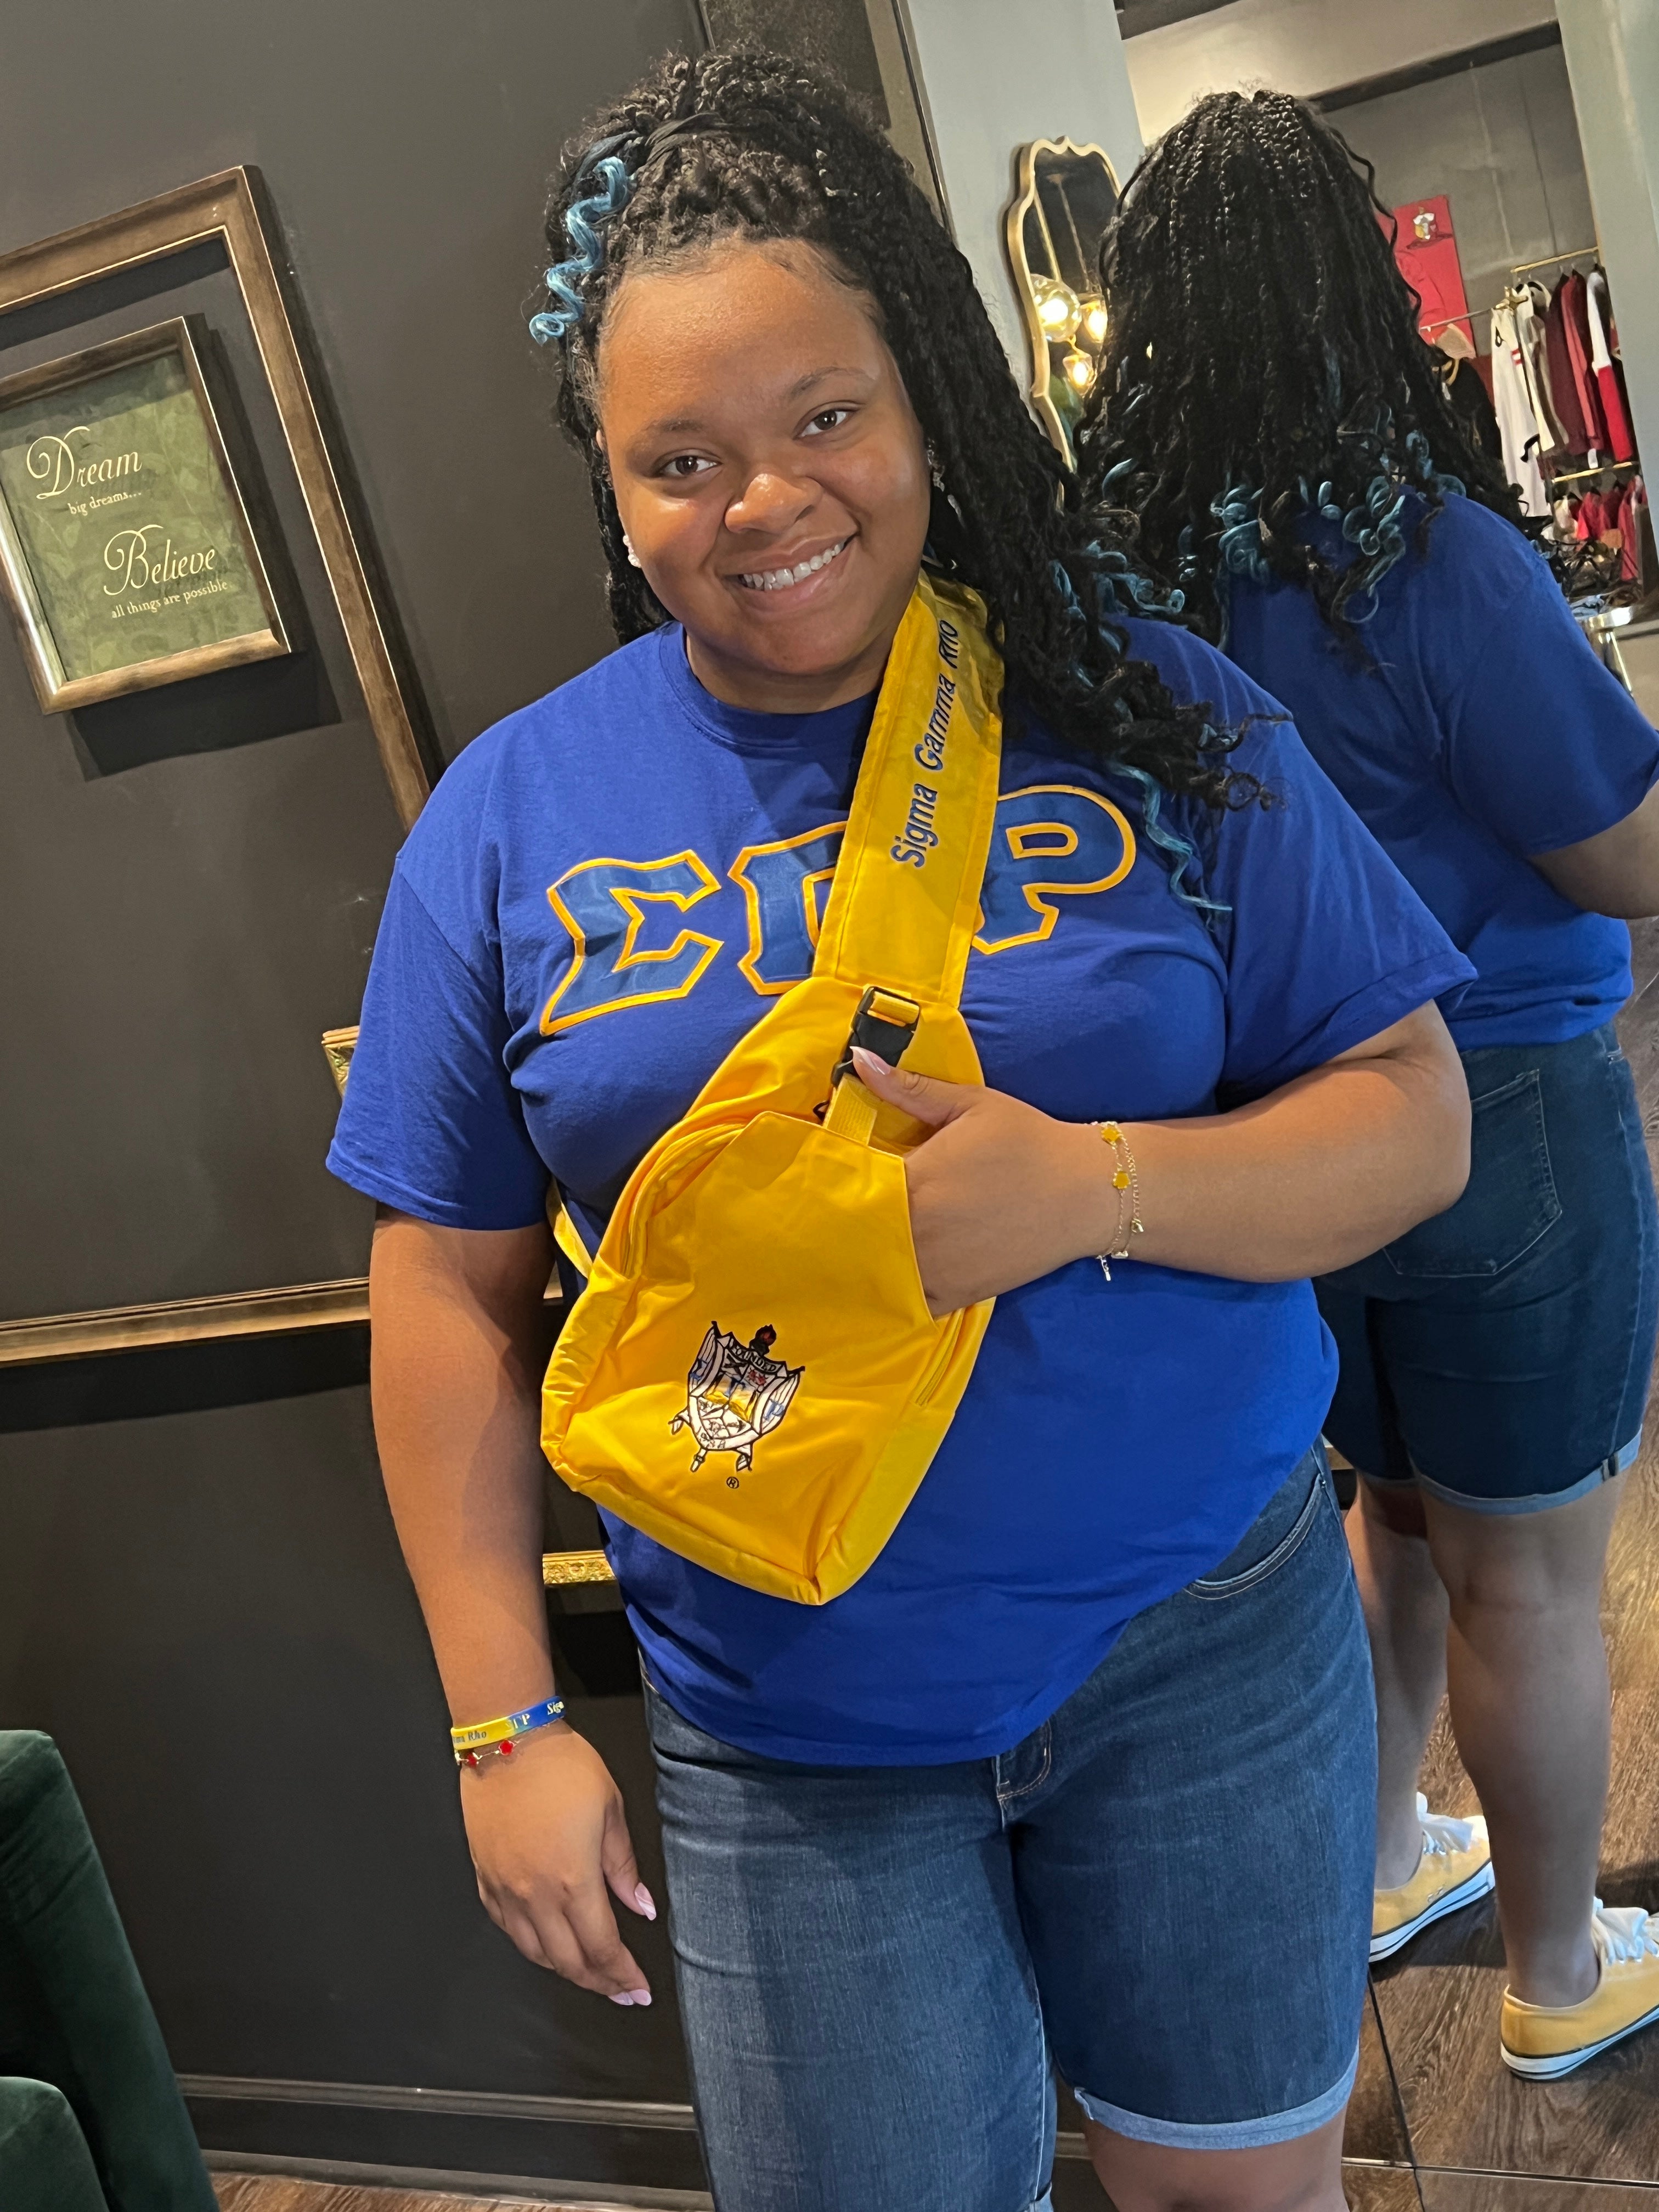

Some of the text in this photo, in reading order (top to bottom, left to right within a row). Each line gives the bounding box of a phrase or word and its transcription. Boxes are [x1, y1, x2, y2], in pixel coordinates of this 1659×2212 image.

[27, 426, 143, 499] Dream
[67, 501, 88, 516] big
[103, 524, 216, 596] Believe
[111, 604, 126, 618] all
[127, 601, 161, 613] things
[163, 594, 181, 605] are
[890, 783, 939, 868] Sigma
[915, 673, 956, 771] Gamma
